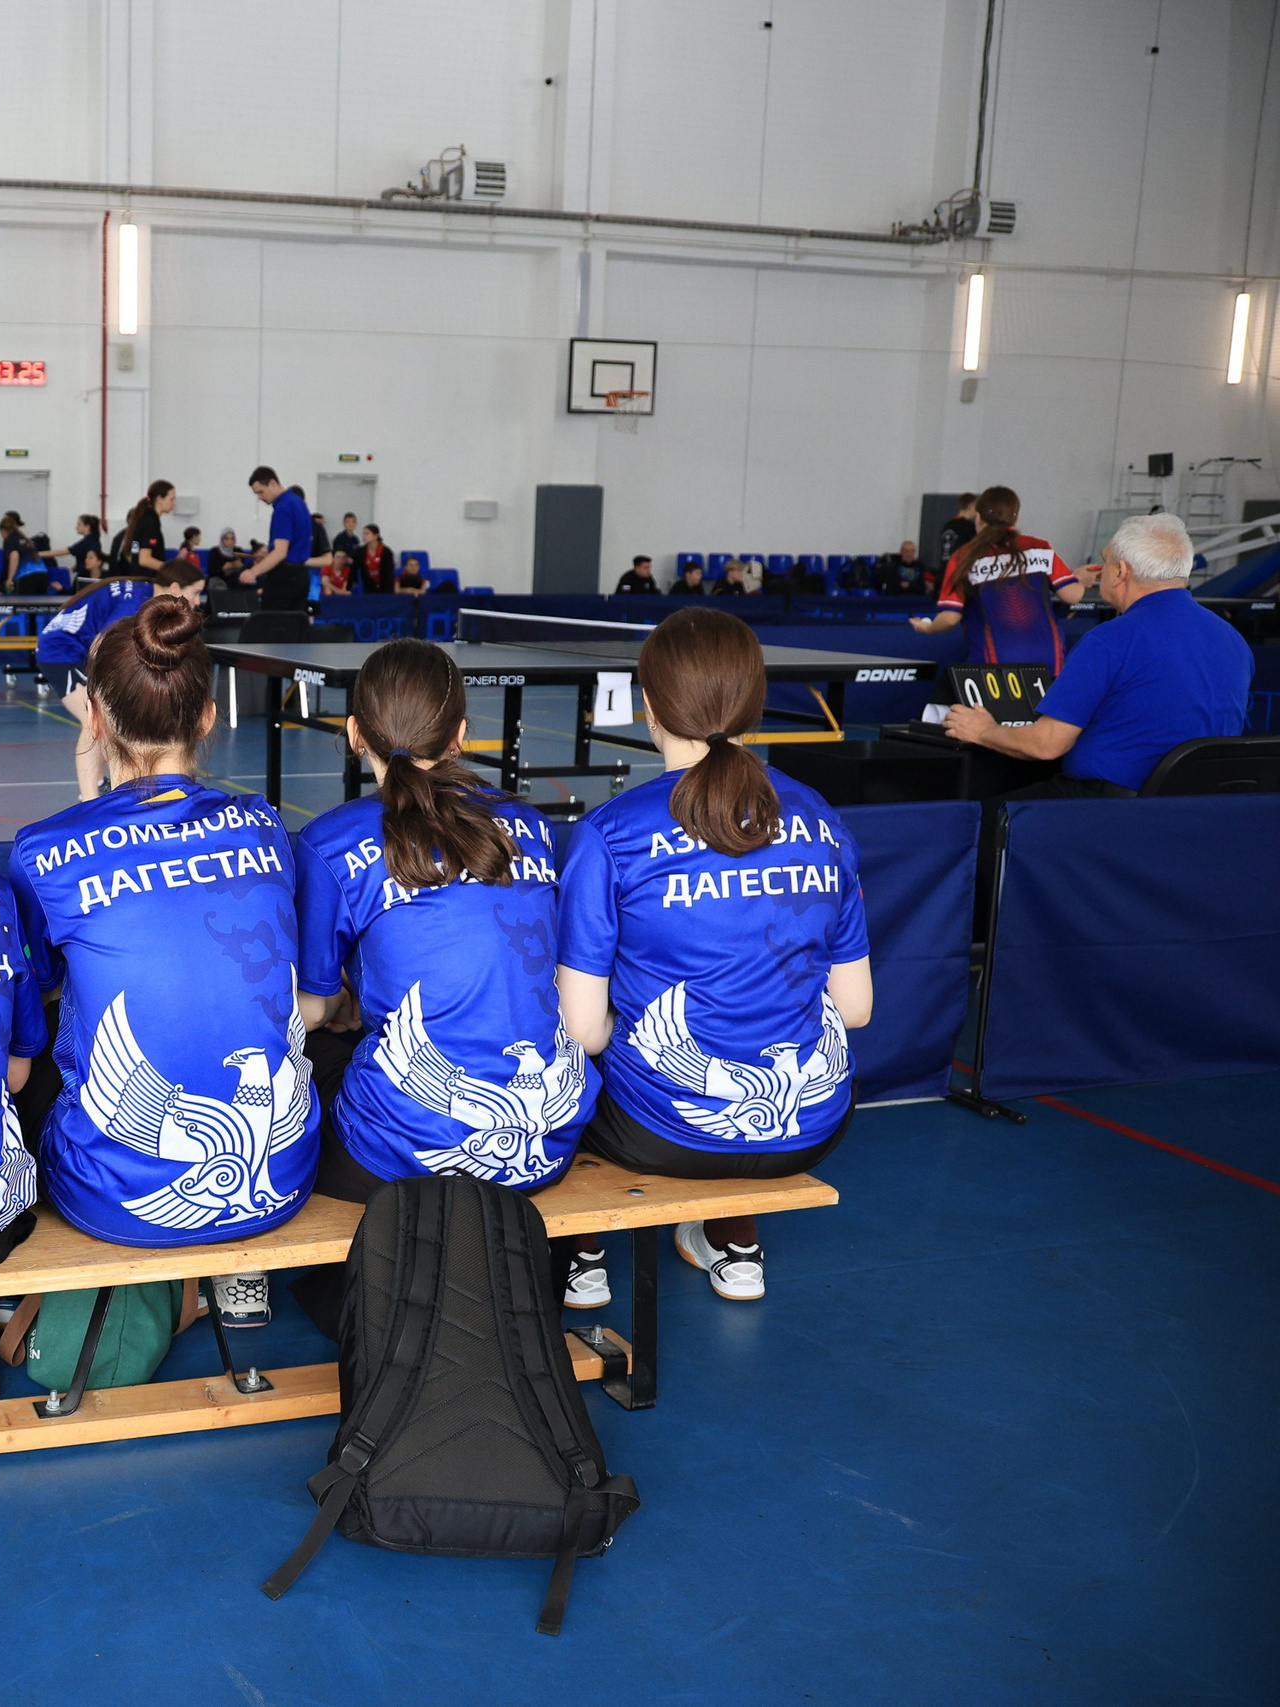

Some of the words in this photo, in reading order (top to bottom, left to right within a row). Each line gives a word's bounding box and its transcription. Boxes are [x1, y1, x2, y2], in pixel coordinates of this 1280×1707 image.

[293, 667, 326, 686] DONIC
[499, 674, 526, 686] 909
[854, 668, 918, 682] DONIC
[986, 672, 1000, 699] 0
[1007, 672, 1022, 699] 0
[605, 688, 616, 712] 1
[35, 804, 261, 877] МАГОМЕДОВА
[817, 818, 840, 849] А.
[77, 845, 283, 915] ДАГЕСТАН
[662, 864, 839, 909] ДАГЕСТАН
